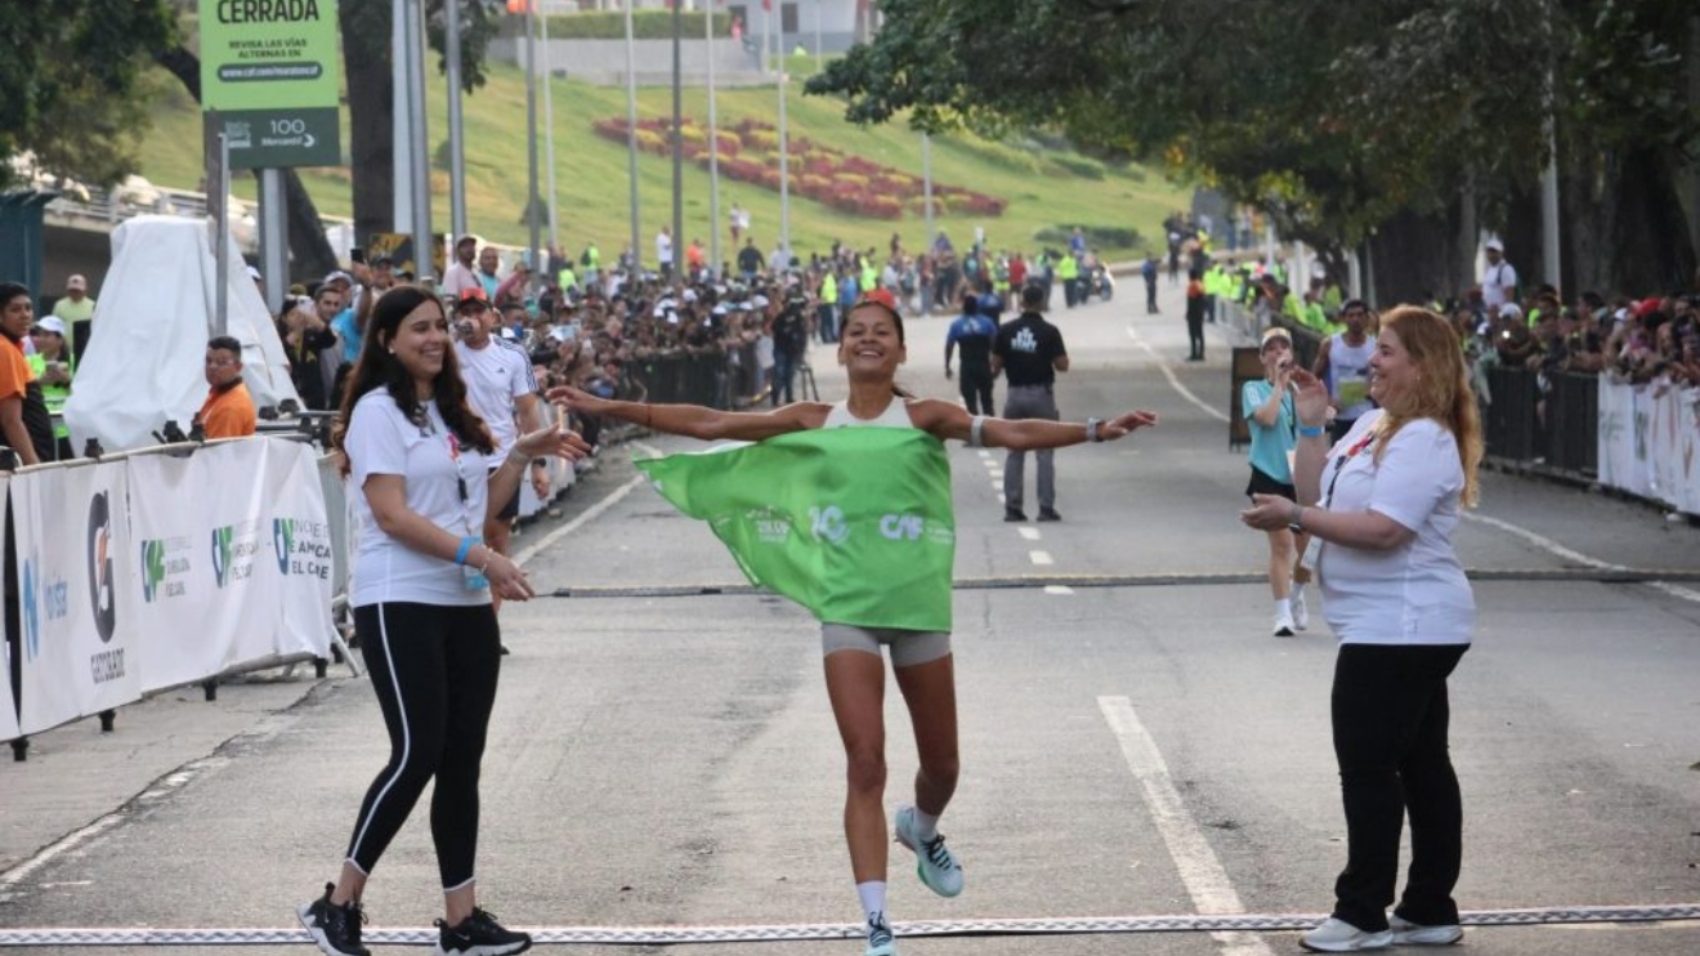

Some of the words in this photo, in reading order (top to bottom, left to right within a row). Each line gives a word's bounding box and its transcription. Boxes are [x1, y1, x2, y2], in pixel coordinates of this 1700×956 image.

[217, 0, 319, 23] CERRADA
[229, 40, 263, 49] REVISA
[265, 39, 283, 48] LAS
[238, 49, 286, 58] ALTERNAS
[288, 49, 301, 57] EN
[270, 119, 306, 134] 100
